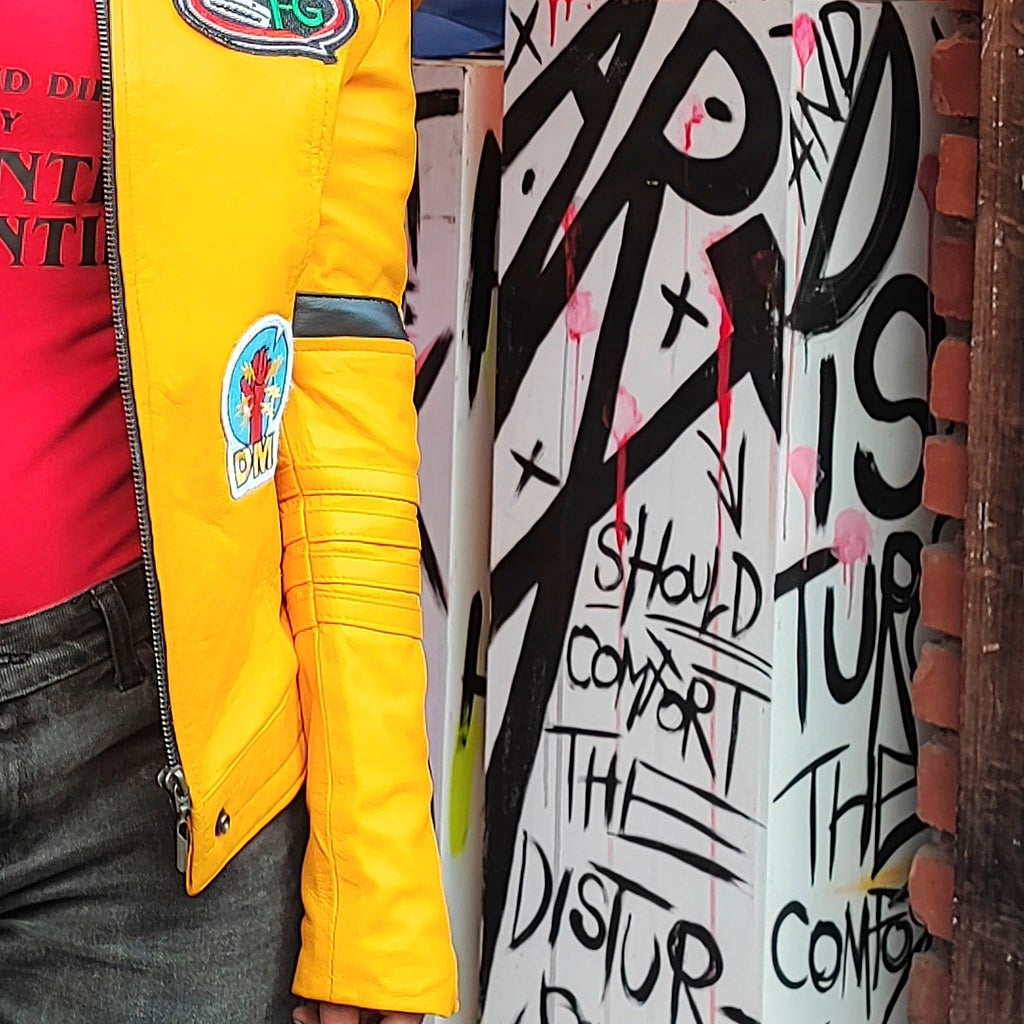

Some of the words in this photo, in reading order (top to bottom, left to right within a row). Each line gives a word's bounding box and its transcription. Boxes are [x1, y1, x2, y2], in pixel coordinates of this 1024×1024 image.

[233, 431, 275, 489] DM
[593, 503, 763, 641] SHOULD
[566, 623, 772, 798] COMFORT
[544, 724, 768, 890] THE
[773, 743, 929, 888] THE
